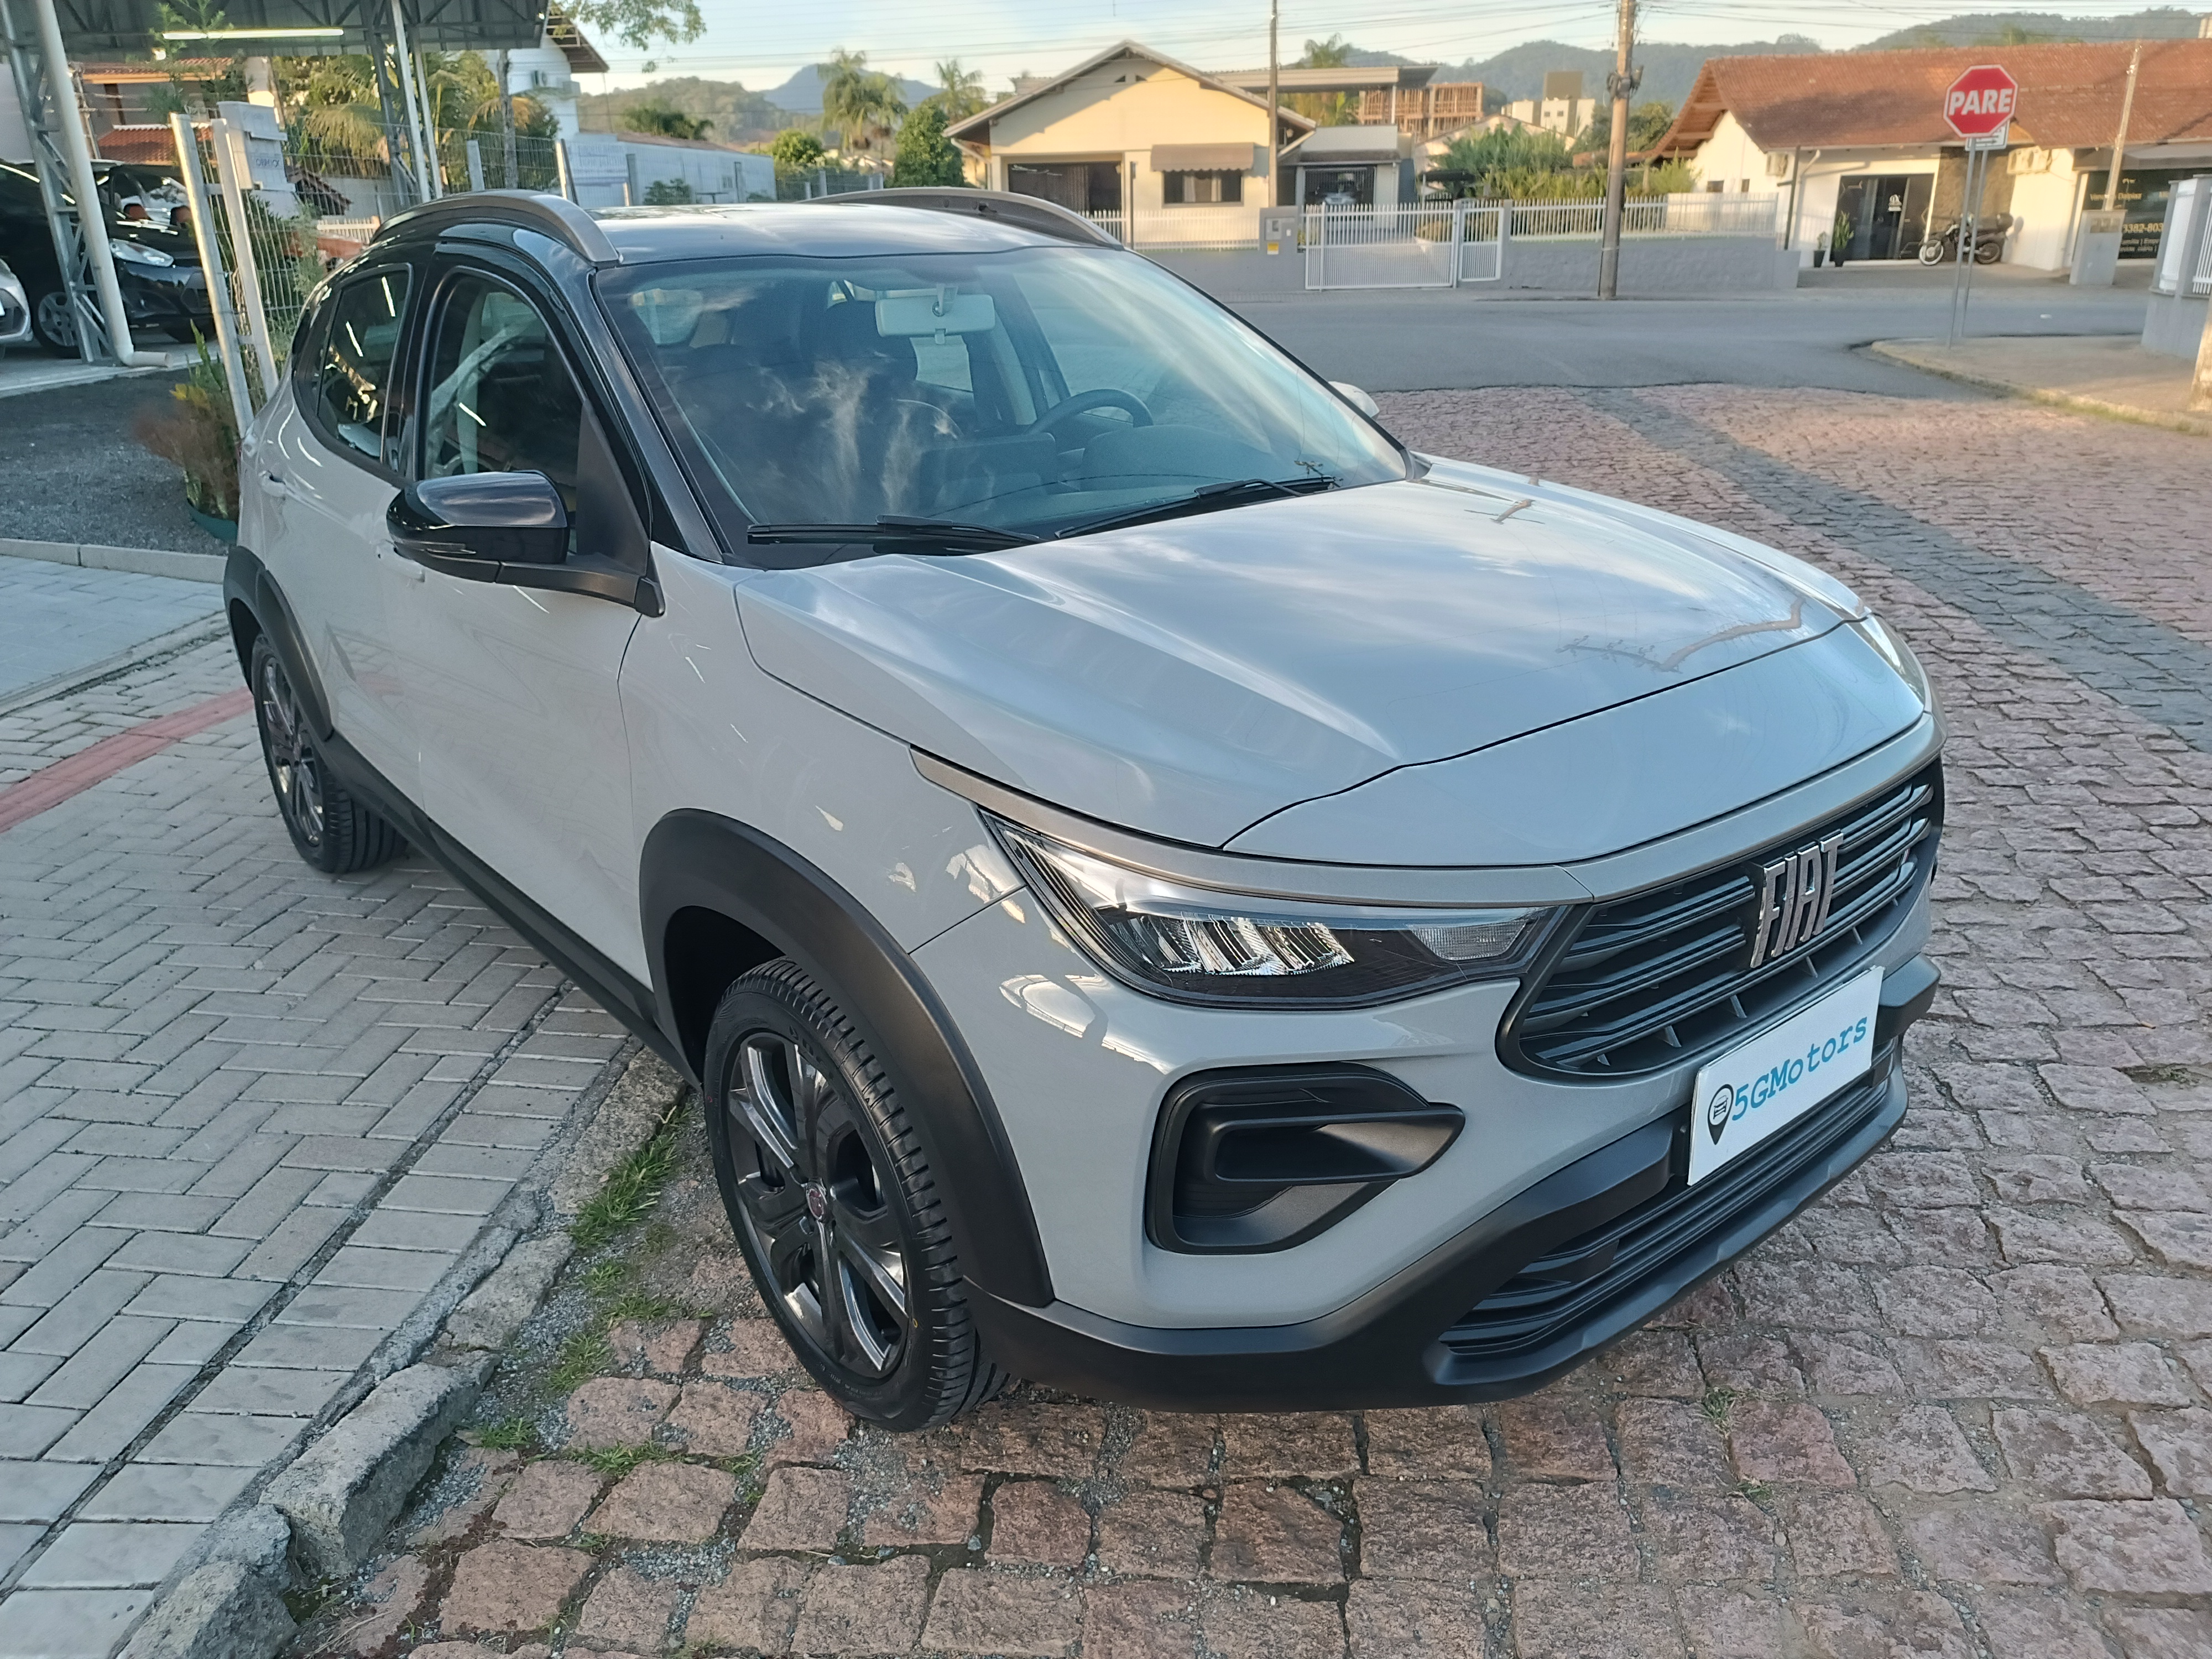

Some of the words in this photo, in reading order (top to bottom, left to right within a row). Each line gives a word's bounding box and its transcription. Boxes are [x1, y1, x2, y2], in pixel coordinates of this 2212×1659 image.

[1948, 88, 2013, 116] PARE
[1750, 831, 1844, 968] FIAT
[1732, 1016, 1867, 1120] 5GMotors
